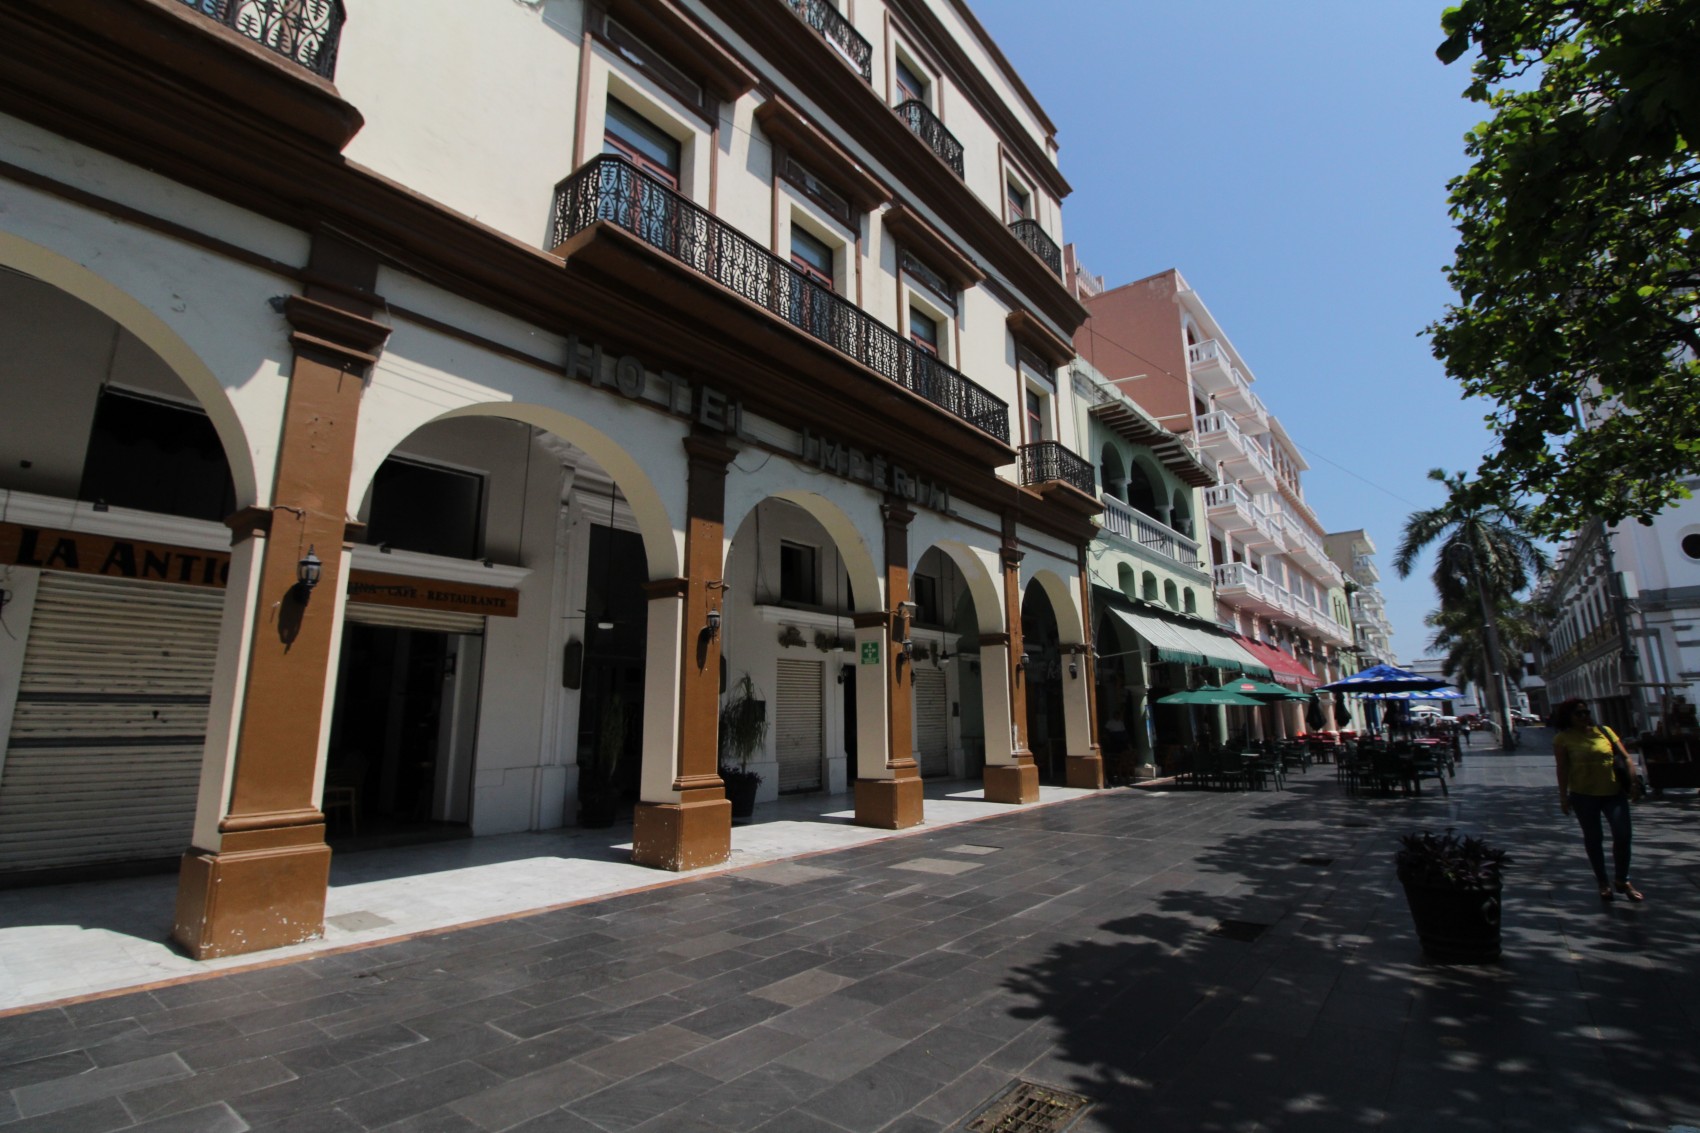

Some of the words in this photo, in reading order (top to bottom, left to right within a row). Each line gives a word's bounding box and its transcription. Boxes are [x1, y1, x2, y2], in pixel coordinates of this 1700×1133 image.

[566, 334, 757, 444] HOTEL
[16, 528, 79, 569] LA
[427, 590, 507, 608] RESTAURANTE
